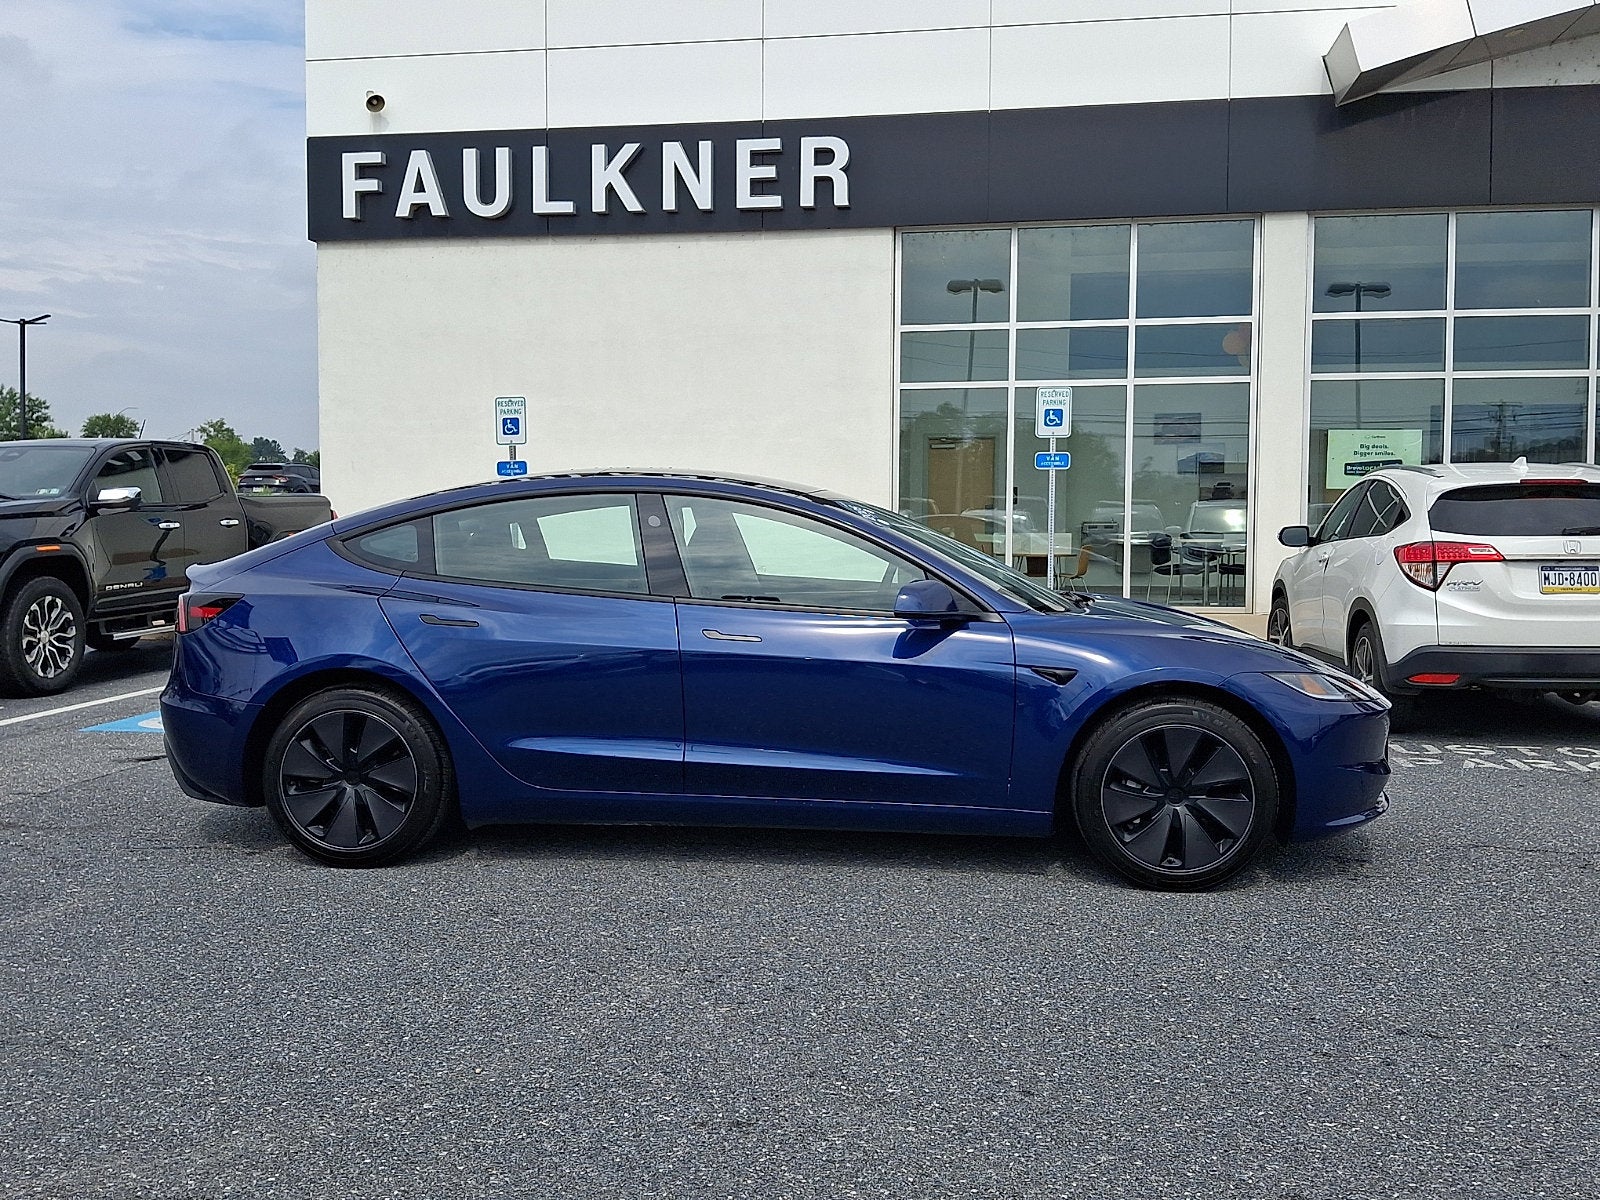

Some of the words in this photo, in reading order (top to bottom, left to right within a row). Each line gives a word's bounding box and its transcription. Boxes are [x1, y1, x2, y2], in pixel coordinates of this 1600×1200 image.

[340, 135, 851, 221] FAULKNER
[1040, 390, 1070, 398] RESERVED
[105, 582, 143, 591] DENALI
